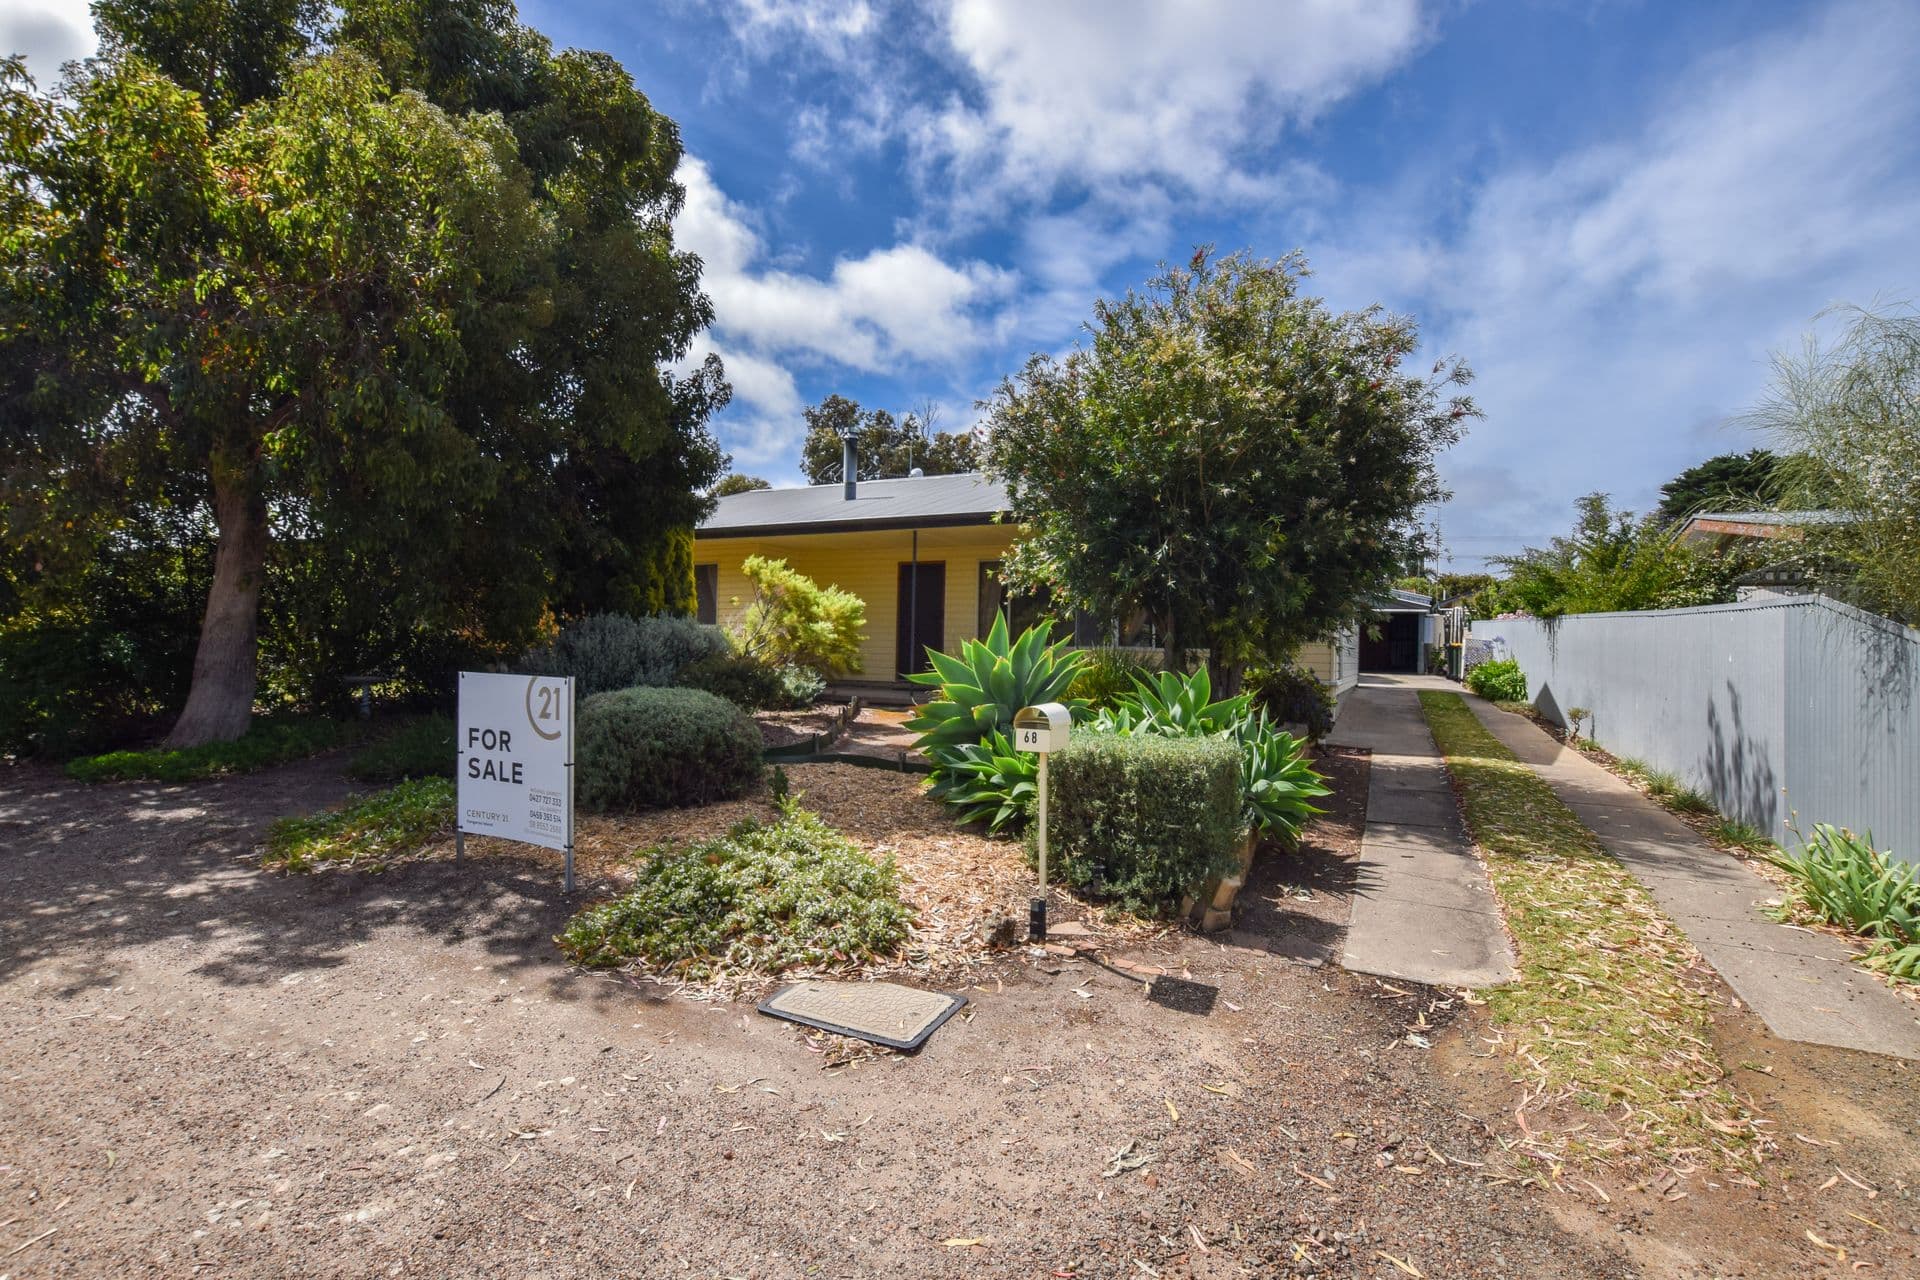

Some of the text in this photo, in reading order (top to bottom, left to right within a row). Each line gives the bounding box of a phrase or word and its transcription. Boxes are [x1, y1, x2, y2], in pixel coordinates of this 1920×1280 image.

[468, 728, 511, 752] FOR
[1024, 731, 1037, 743] 68
[468, 757, 523, 785] SALE
[466, 809, 509, 823] CENTURY 21
